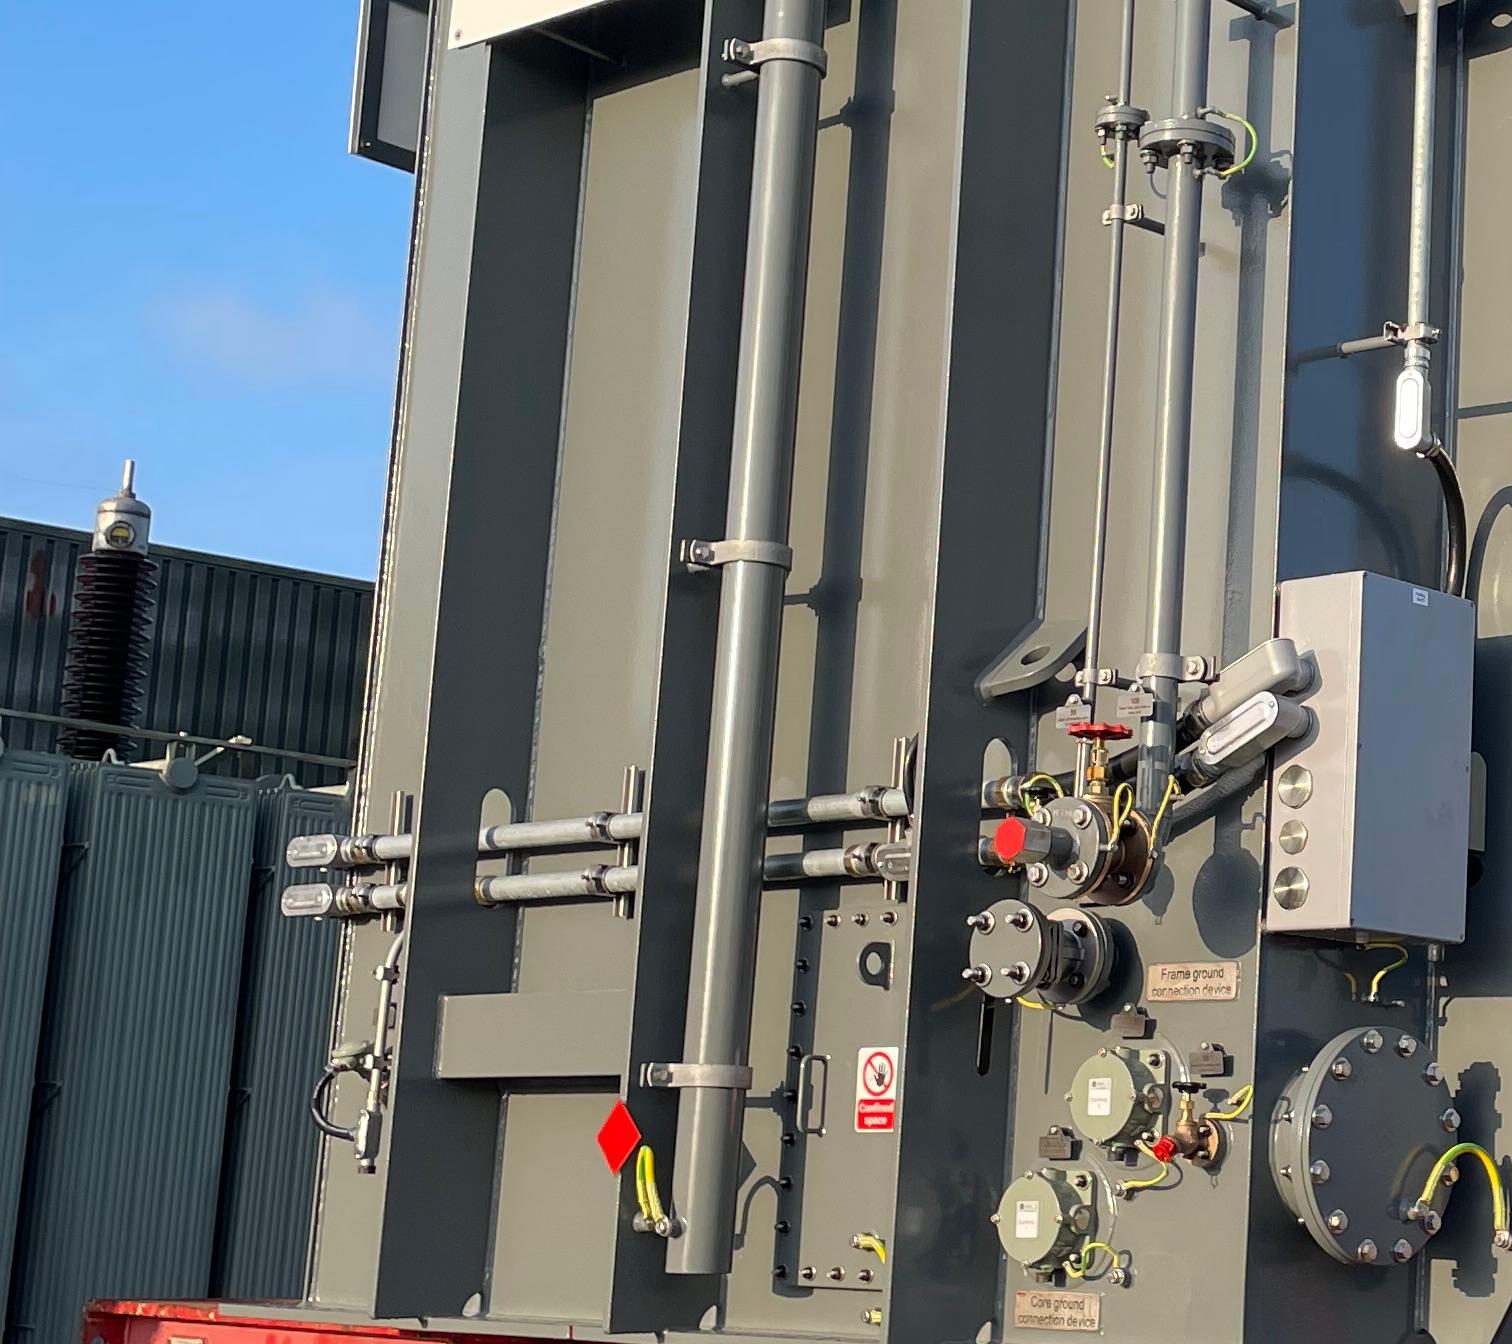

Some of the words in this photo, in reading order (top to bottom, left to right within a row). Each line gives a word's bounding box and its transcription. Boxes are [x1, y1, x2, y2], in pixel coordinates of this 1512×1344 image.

[1161, 967, 1191, 980] Frame
[1192, 968, 1224, 983] ground
[1152, 985, 1200, 997] connection
[1202, 983, 1232, 996] device
[859, 1102, 894, 1113] Confined
[864, 1116, 888, 1127] space
[1030, 1296, 1052, 1309] Core
[1053, 1297, 1085, 1313] ground
[1017, 1314, 1065, 1326] connection
[1066, 1315, 1096, 1328] device
